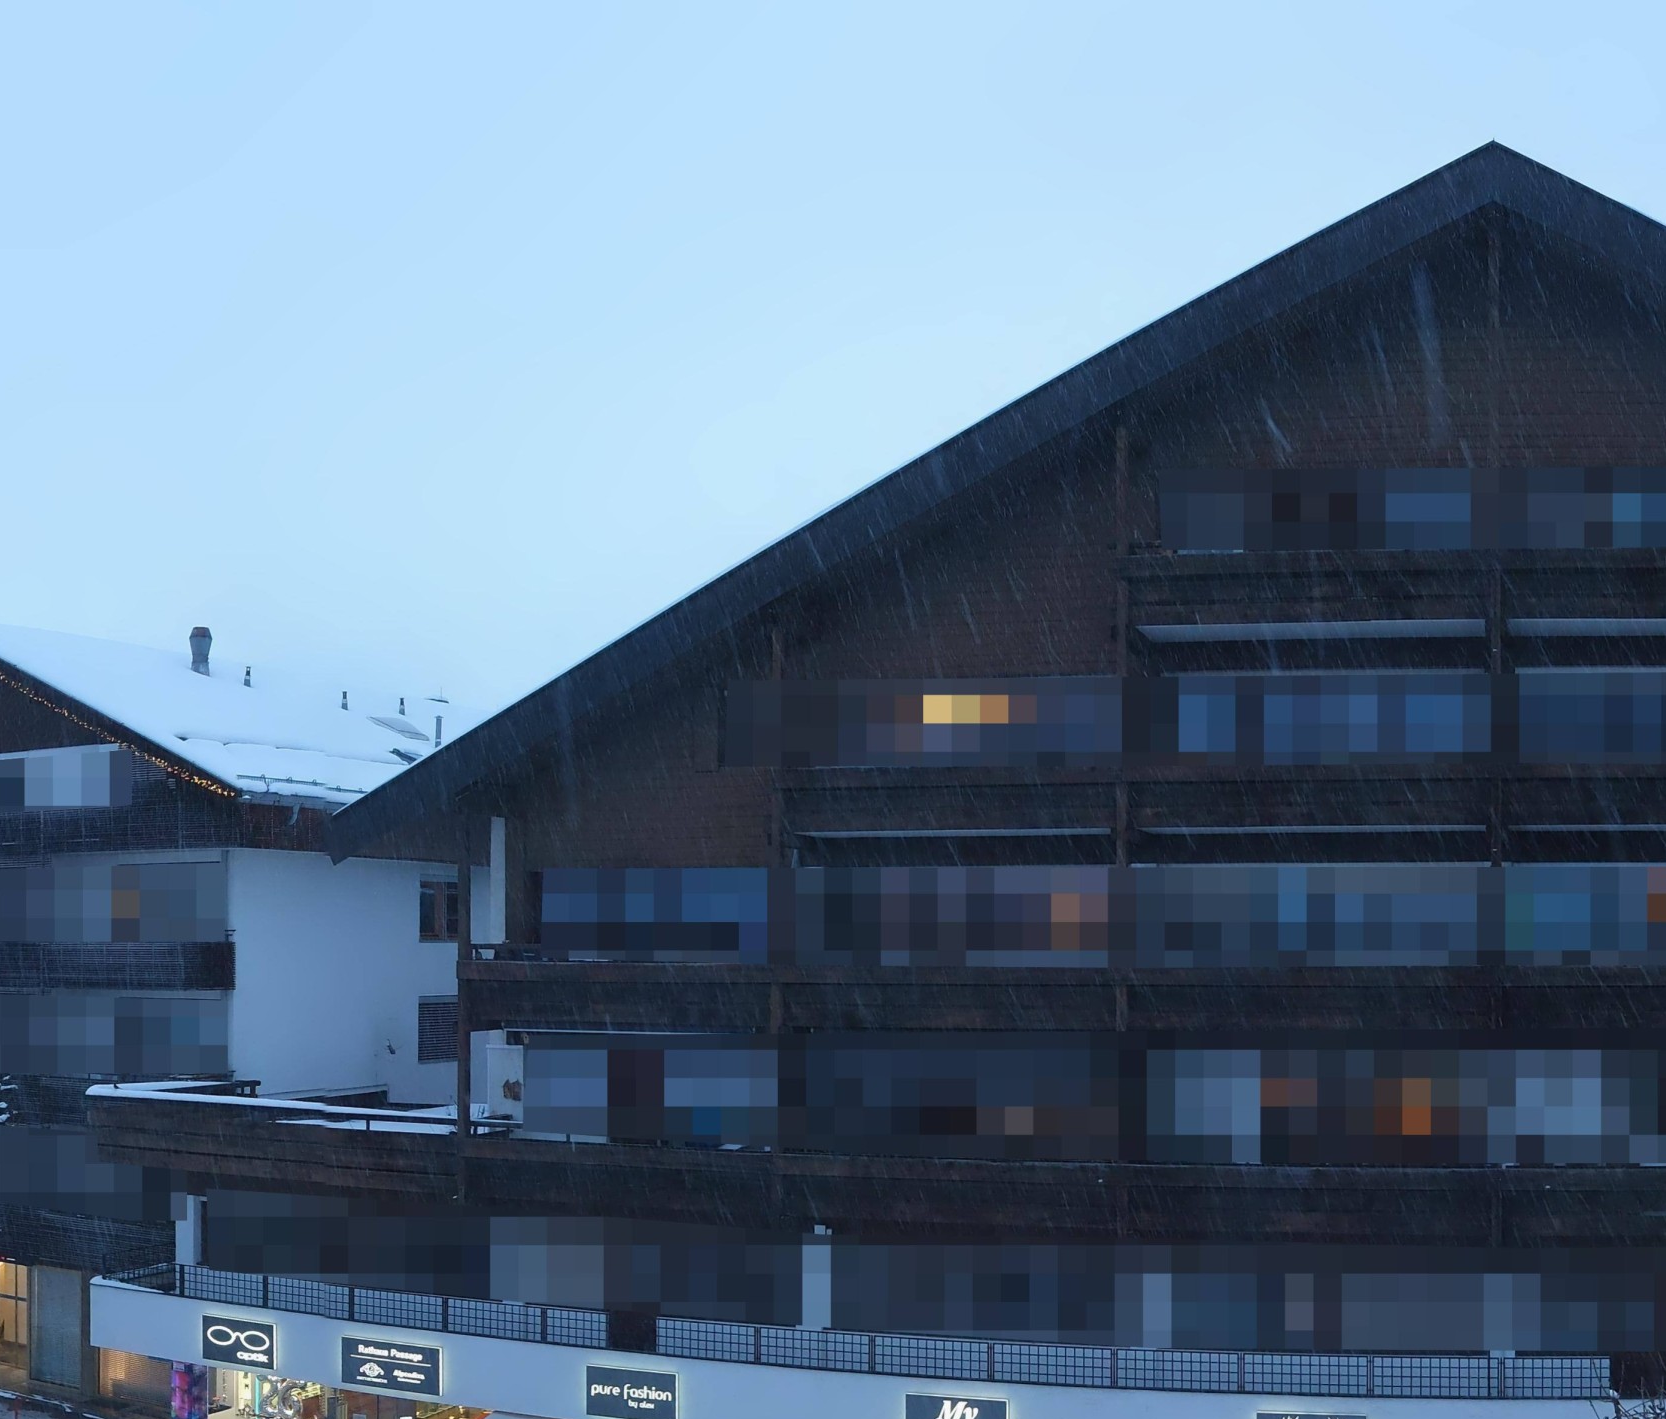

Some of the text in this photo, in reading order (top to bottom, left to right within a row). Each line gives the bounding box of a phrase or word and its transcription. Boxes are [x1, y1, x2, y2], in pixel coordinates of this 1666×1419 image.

[236, 1350, 269, 1363] optik
[590, 1384, 672, 1401] pure fashion
[628, 1400, 638, 1409] by
